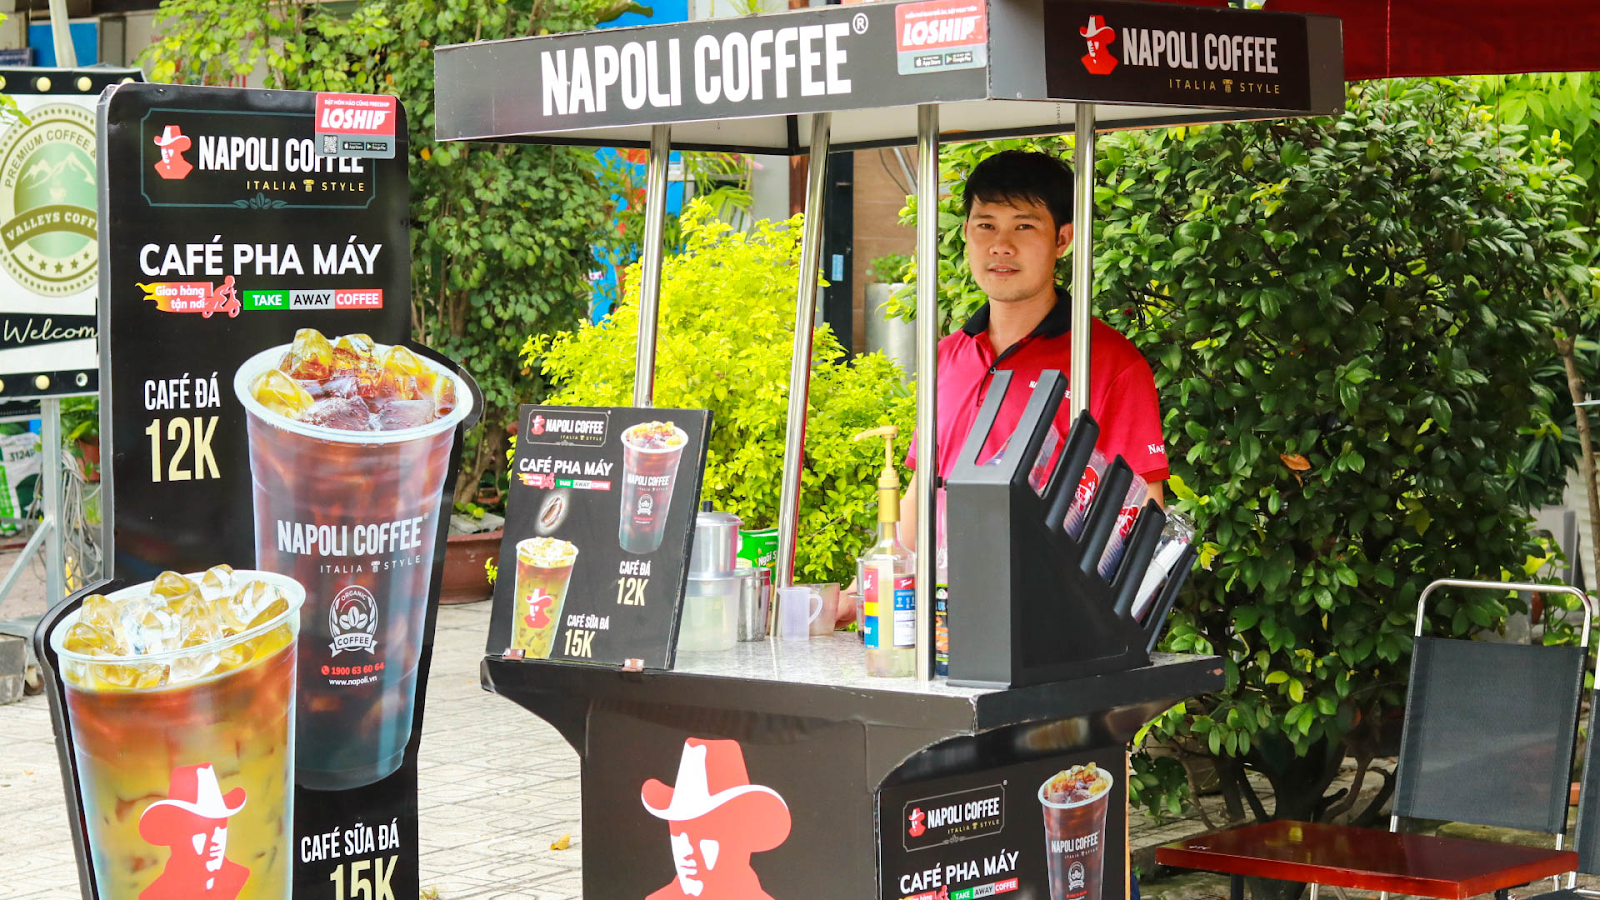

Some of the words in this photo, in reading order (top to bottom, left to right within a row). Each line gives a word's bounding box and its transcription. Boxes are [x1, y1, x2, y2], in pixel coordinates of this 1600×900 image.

[902, 15, 982, 46] LOSHIP
[1122, 27, 1199, 70] NAPOLI
[1204, 33, 1279, 74] COFFEE
[540, 38, 682, 116] NAPOLI
[694, 22, 852, 104] COFFEE
[1169, 78, 1217, 91] ITALIA
[1239, 82, 1281, 94] STYLE
[321, 108, 392, 130] LOSHIP
[4, 134, 44, 189] PREMIUM
[46, 129, 91, 151] COFFEE
[198, 135, 278, 172] NAPOLI
[246, 180, 298, 192] ITALIA
[320, 181, 364, 192] STYLE
[6, 211, 60, 242] VALLEYS
[139, 235, 225, 277] CAFÉ
[233, 243, 305, 276] PHA
[313, 235, 382, 274] MÁY
[154, 285, 178, 296] Giao
[179, 284, 205, 298] hàng
[252, 294, 282, 306] TAKE
[294, 294, 331, 305] AWAY
[336, 293, 379, 305] COFFEE
[170, 298, 188, 310] tận
[144, 372, 191, 411] CAFÉ
[194, 371, 221, 409] ĐÁ
[546, 418, 574, 433] NAPOLI
[574, 420, 604, 434] COFFEE
[145, 416, 221, 483] 12K
[520, 456, 552, 473] CAFÉ
[554, 460, 581, 475] PHA
[584, 458, 614, 476] MÁY
[648, 476, 670, 486] COFFEE
[277, 520, 348, 556] NAPOLI
[353, 516, 423, 556] COFFEE
[320, 564, 363, 574] ITALIA
[384, 555, 421, 570] STYLE
[619, 560, 639, 576] CAFÉ
[340, 590, 368, 602] ORGANIC
[617, 577, 648, 606] 12K
[567, 614, 584, 628] CAFÉ
[336, 636, 370, 646] COFFEE
[564, 630, 596, 658] 15K
[331, 666, 350, 675] 1900
[351, 665, 362, 675] 63
[363, 664, 374, 674] 60
[374, 662, 385, 672] 64
[328, 675, 378, 686] www.napoli.vn
[928, 804, 962, 830] NAPOLI
[964, 797, 1000, 820] COFFEE
[947, 824, 970, 834] ITALIA
[980, 819, 1000, 828] STYLE
[301, 826, 340, 863] CAFÉ
[344, 821, 376, 856] SỮA
[378, 817, 400, 851] ĐÁ
[1051, 839, 1074, 853] NAPOLI
[1075, 832, 1099, 851] COFFEE
[329, 855, 400, 900] 15K
[900, 862, 942, 894] CAFÉ
[946, 860, 980, 885] PHA
[984, 848, 1020, 876] MÁY
[955, 891, 971, 900] TAKE
[974, 885, 994, 896] AWAY
[995, 880, 1017, 892] COFFEE
